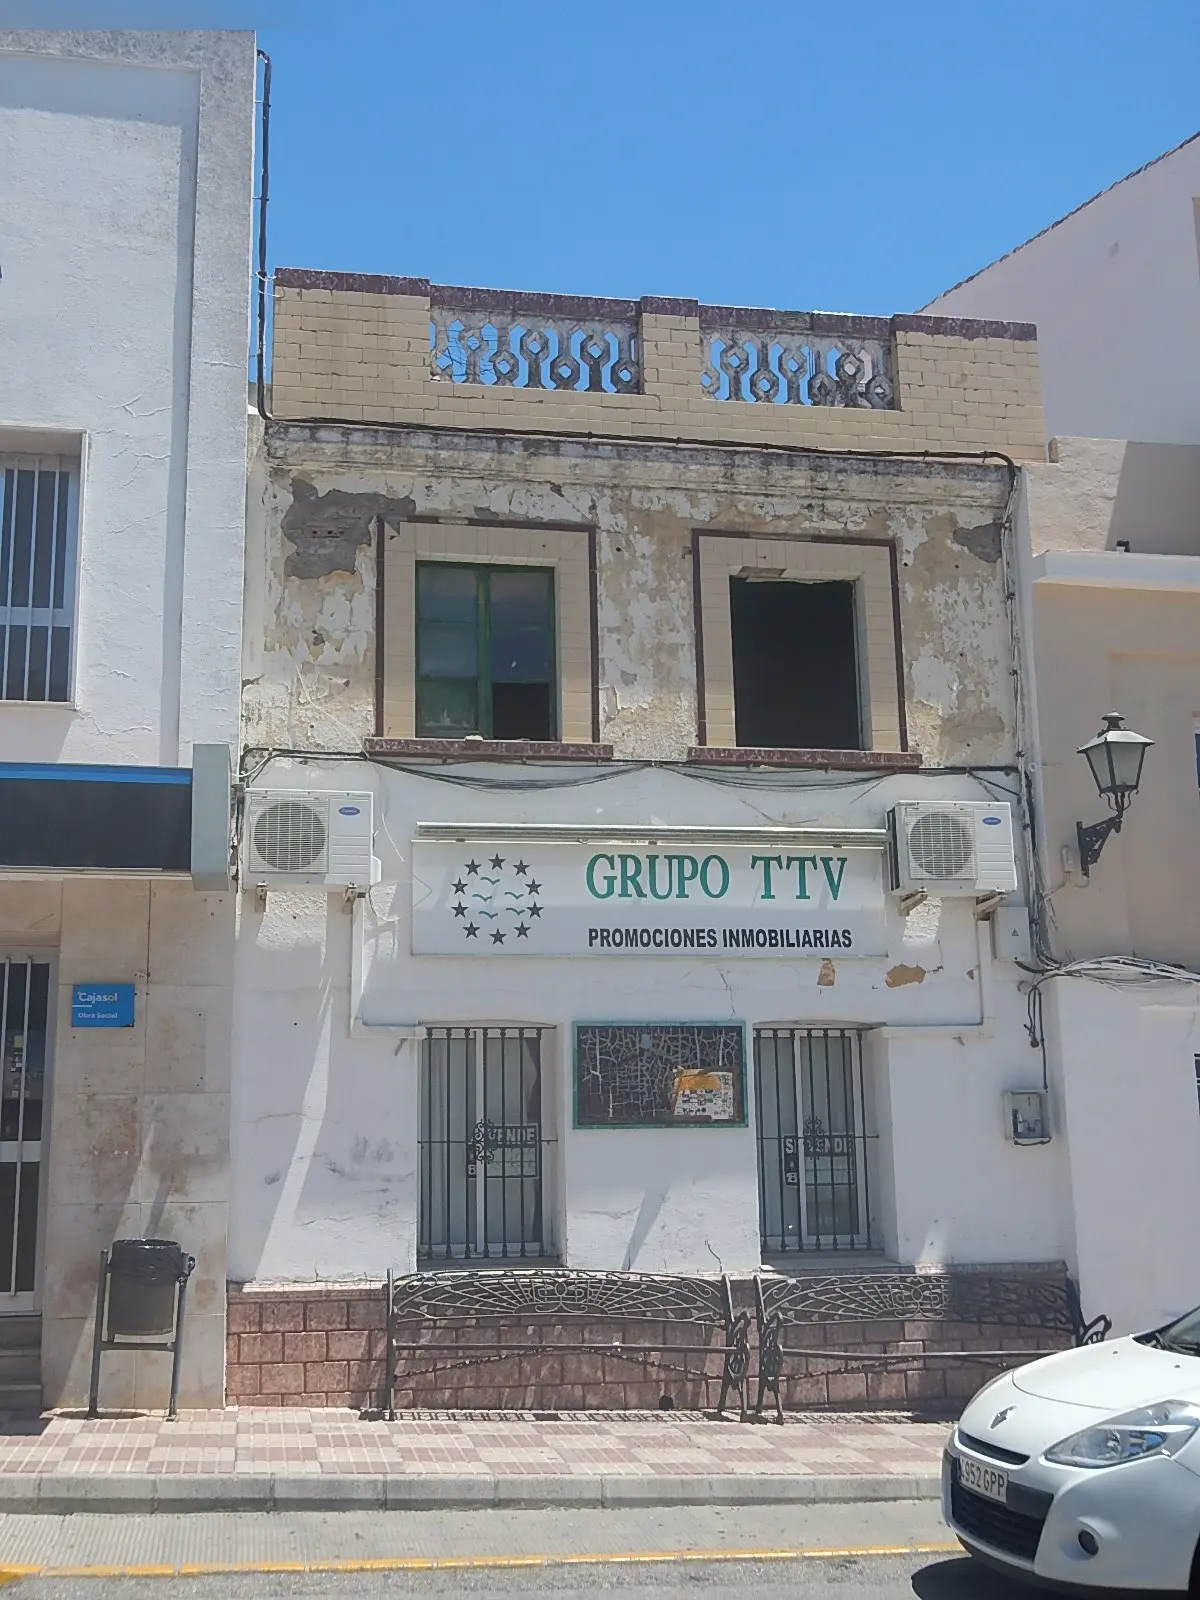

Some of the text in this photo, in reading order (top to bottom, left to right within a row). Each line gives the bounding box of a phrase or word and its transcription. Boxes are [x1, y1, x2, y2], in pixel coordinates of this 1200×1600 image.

[586, 853, 848, 901] GRUPO TTV
[588, 928, 853, 948] PROMOCIONES INMOBILIARIAS
[78, 992, 118, 1004] Cajasol
[77, 1011, 96, 1019] Obra
